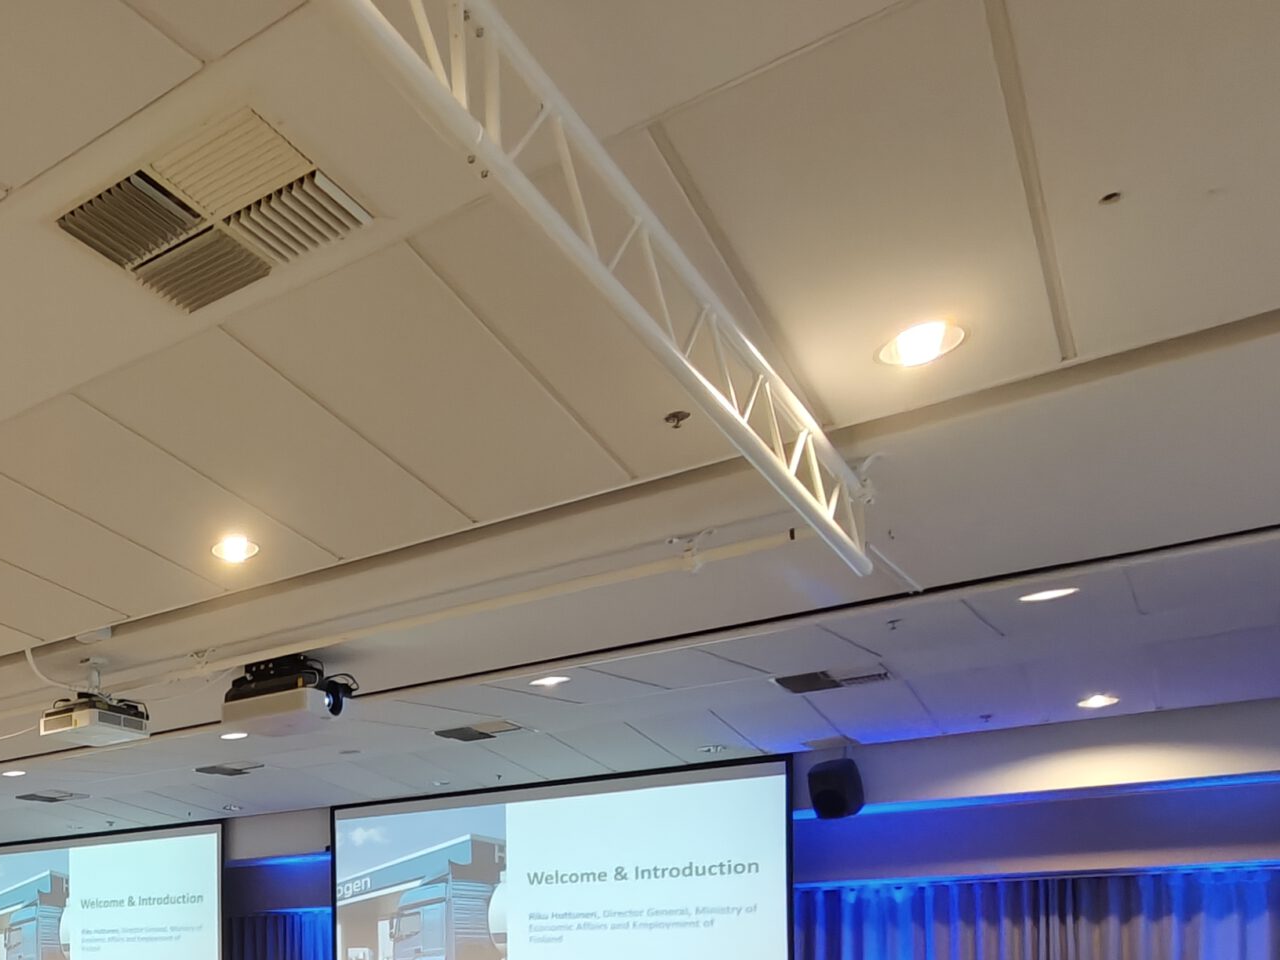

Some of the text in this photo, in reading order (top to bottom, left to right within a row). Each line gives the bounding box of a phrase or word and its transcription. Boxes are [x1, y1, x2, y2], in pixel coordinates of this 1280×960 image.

[527, 860, 760, 886] Welcome & Introduction
[81, 893, 204, 909] Welcome & Introduction
[745, 903, 757, 913] of
[703, 919, 714, 928] of
